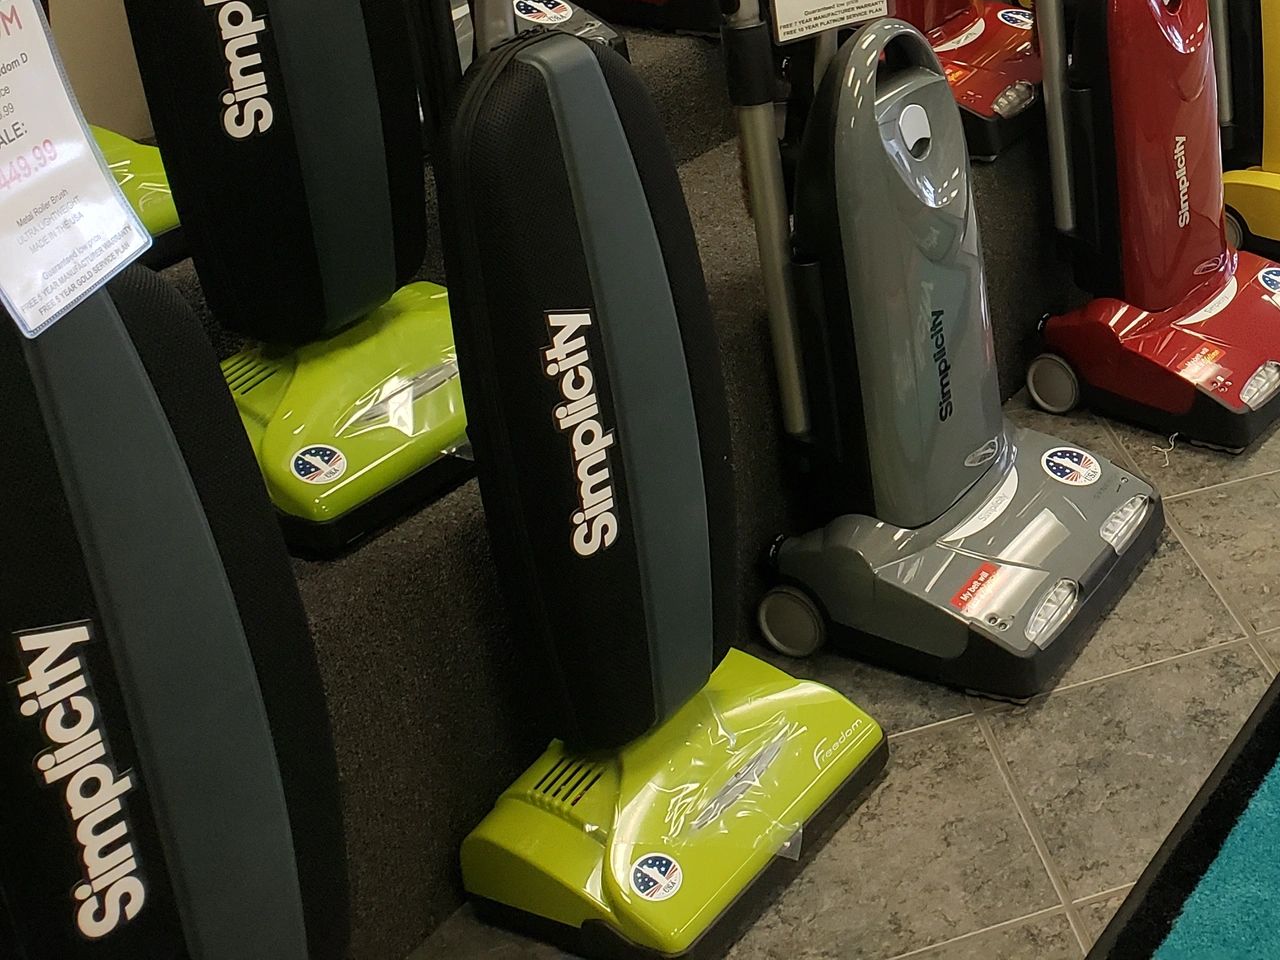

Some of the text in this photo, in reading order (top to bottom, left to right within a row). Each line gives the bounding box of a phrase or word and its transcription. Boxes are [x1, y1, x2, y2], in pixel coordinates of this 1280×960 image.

[799, 17, 812, 25] YEAR
[813, 7, 856, 21] MANUFACTURER
[856, 0, 885, 10] WARRANTY
[846, 11, 868, 19] SERVICE
[21, 52, 29, 64] D
[0, 121, 28, 149] ALE:
[0, 138, 58, 190] 449.99
[1174, 136, 1190, 228] Simplicity
[16, 189, 68, 227] Metal Roller Brush
[17, 195, 80, 245] ULTRA LIGHTWEIGHT
[29, 238, 49, 254] MADE
[55, 221, 72, 235] THE
[71, 211, 84, 226] USA
[21, 298, 40, 314] FREE
[42, 282, 61, 298] YEAR
[58, 246, 104, 283] MANUFACTURER
[38, 300, 57, 315] FREE
[61, 283, 78, 298] YEAR
[77, 270, 94, 286] GOLD
[93, 253, 116, 274] SERVICE
[115, 241, 131, 257] PLAN
[930, 309, 954, 425] Simplicity
[544, 313, 618, 556] Simplicity
[324, 467, 340, 480] USA
[1083, 469, 1100, 482] USA
[960, 570, 990, 603] My belt will
[813, 718, 863, 770] Freedom
[18, 625, 146, 938] Simplicity
[662, 881, 677, 894] USA
